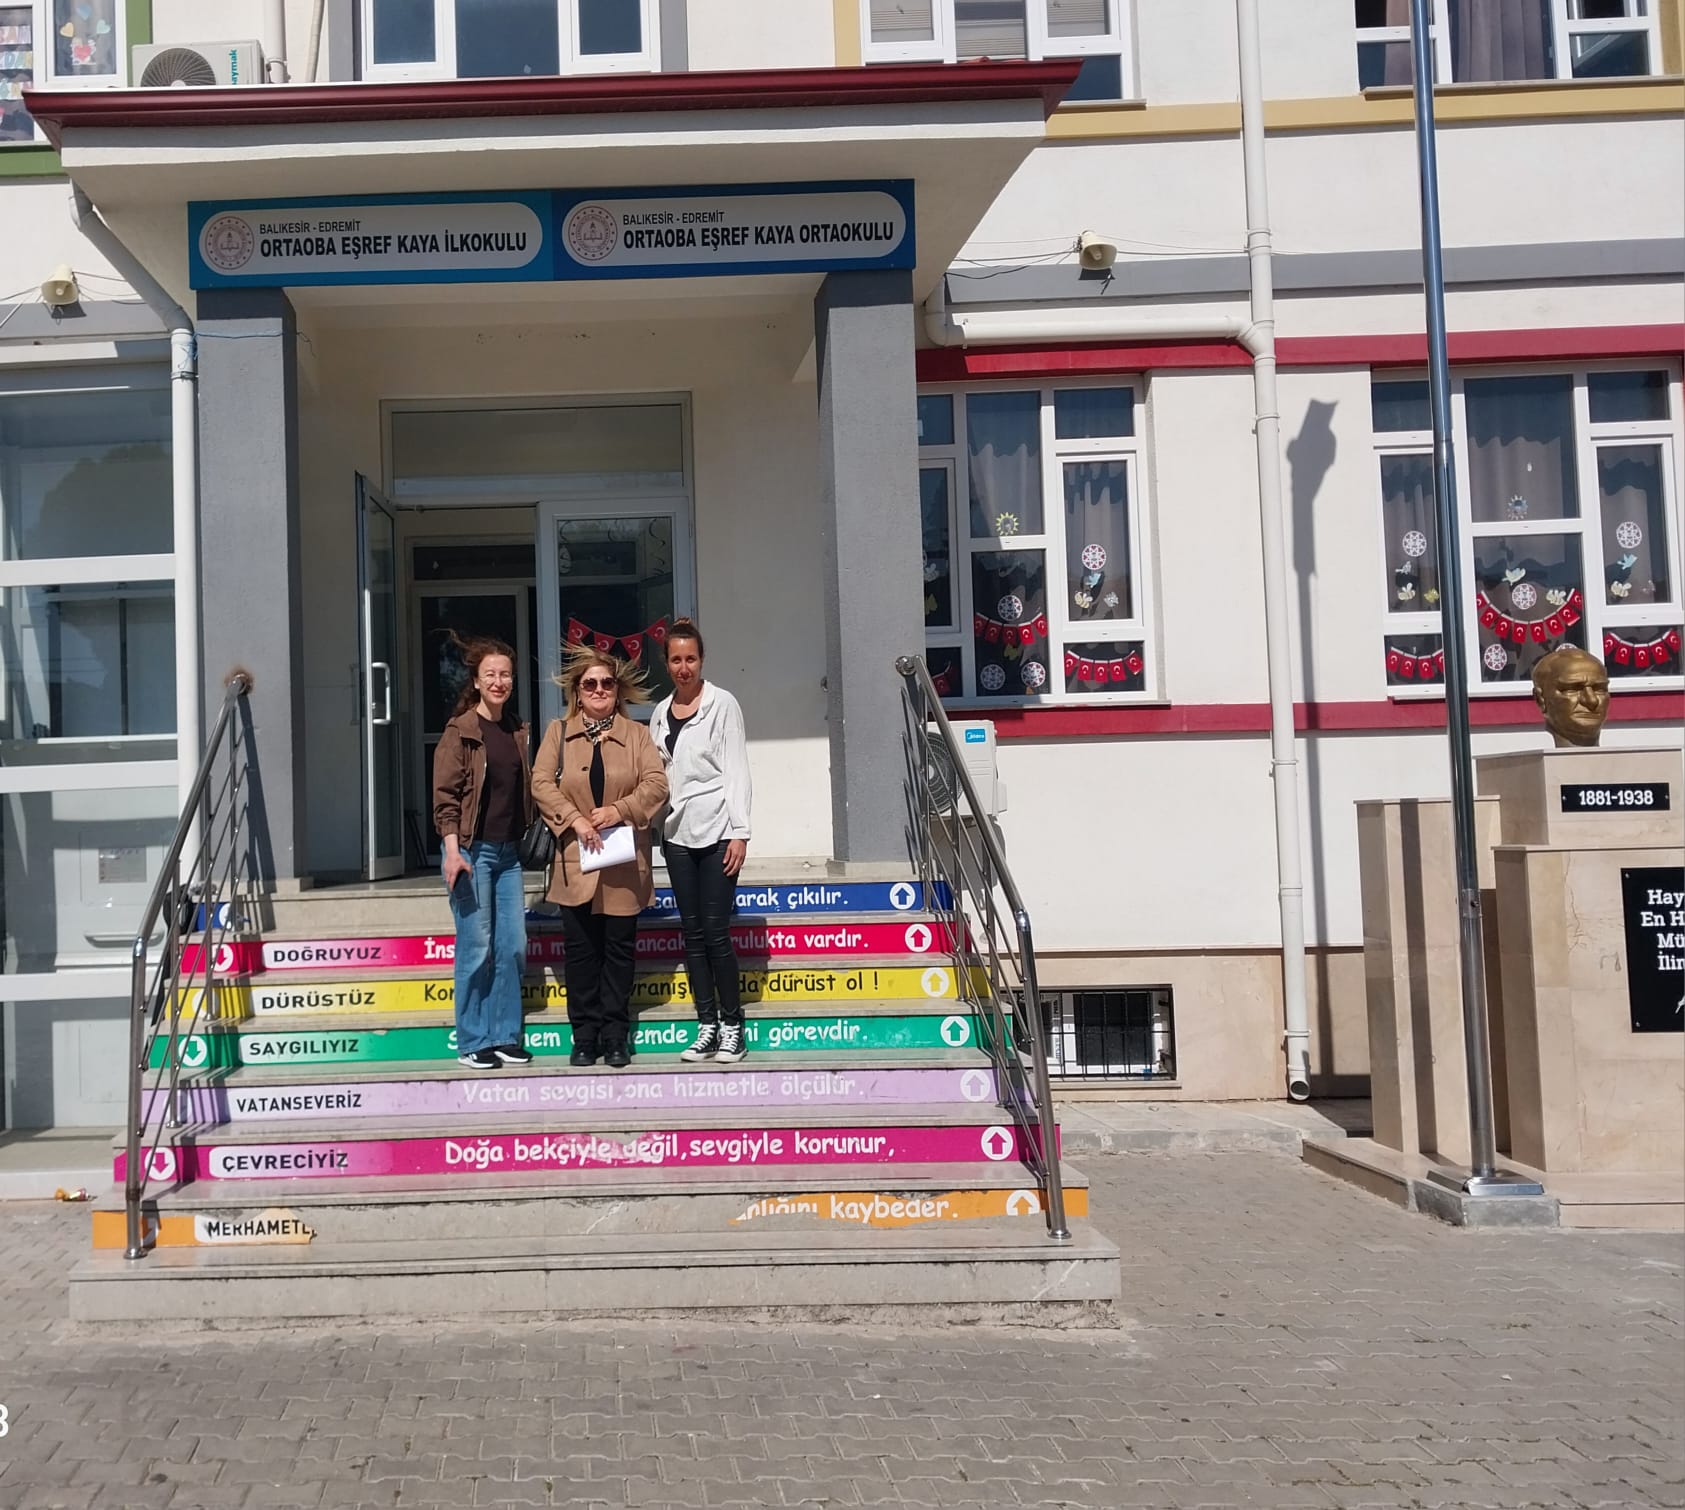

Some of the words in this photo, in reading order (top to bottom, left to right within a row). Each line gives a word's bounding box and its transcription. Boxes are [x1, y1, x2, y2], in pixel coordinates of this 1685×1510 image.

[228, 49, 239, 86] aymak
[259, 220, 311, 234] BALIKESİR
[318, 218, 361, 233] EDREMİT
[623, 211, 674, 226] BALIKESİR
[682, 209, 725, 224] EDREMİT
[260, 238, 337, 257] ORTAOBA
[341, 235, 392, 260] EŞREF
[397, 234, 440, 254] KAYA
[445, 229, 527, 252] İLKOKULU
[623, 228, 697, 249] ORTAOBA
[701, 226, 749, 251] EŞREF
[754, 225, 795, 245] KAYA
[799, 221, 894, 243] ORTAOKULU
[1579, 790, 1654, 806] 1881-1938
[788, 886, 849, 909] çıkılır.
[1640, 911, 1666, 927] En
[803, 928, 869, 949] vardır.
[273, 946, 382, 962] DOĞRUYUZ
[769, 971, 836, 993] dürüst
[846, 971, 863, 991] ol
[262, 989, 376, 1010] DÜRÜSTÜZ
[768, 1020, 868, 1047] görevdir.
[249, 1039, 359, 1056] SAYGILIYIZ
[463, 1081, 530, 1103] Vatan
[674, 1075, 769, 1098] hizmetle
[780, 1073, 865, 1100] ölçülür.
[237, 1090, 362, 1112] VATANSEVERİZ
[222, 1149, 348, 1172] ÇEVRECİYİZ
[445, 1139, 504, 1169] Doğa
[514, 1134, 612, 1166] bekçiyle
[831, 1195, 958, 1224] kaybeder.
[207, 1218, 317, 1238] MERHAMETL
